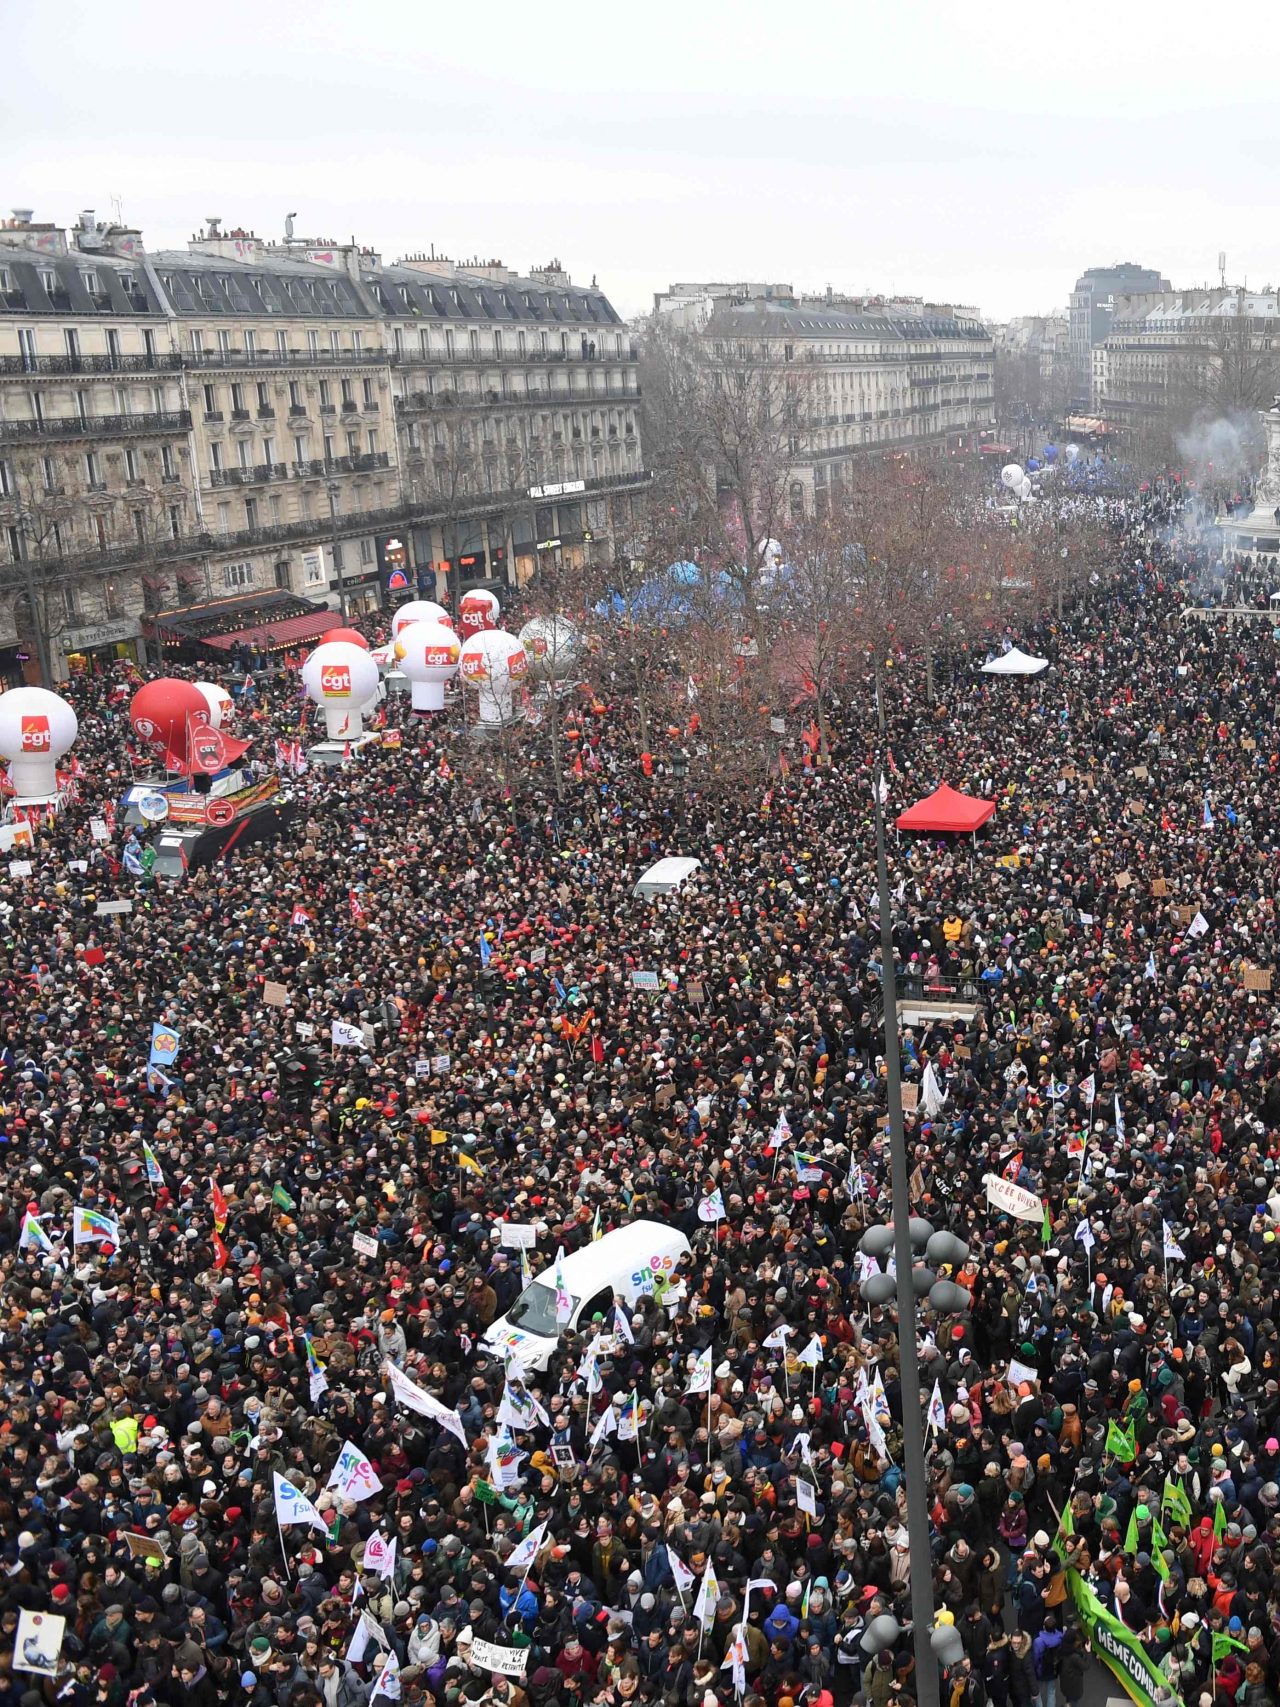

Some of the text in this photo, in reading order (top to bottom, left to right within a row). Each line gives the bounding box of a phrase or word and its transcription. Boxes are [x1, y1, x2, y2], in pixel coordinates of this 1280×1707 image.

[463, 611, 483, 626] cgt
[427, 650, 448, 667] cgt
[463, 658, 479, 675] cgt
[511, 657, 526, 675] cgt
[321, 672, 350, 690] cgt
[21, 728, 51, 746] cgt
[200, 744, 216, 753] CGT
[632, 1255, 673, 1286] snes
[293, 1501, 311, 1516] fsu
[509, 1649, 526, 1657] VIVE
[1097, 1626, 1130, 1666] MÊME
[501, 1662, 525, 1671] RETRAITE
